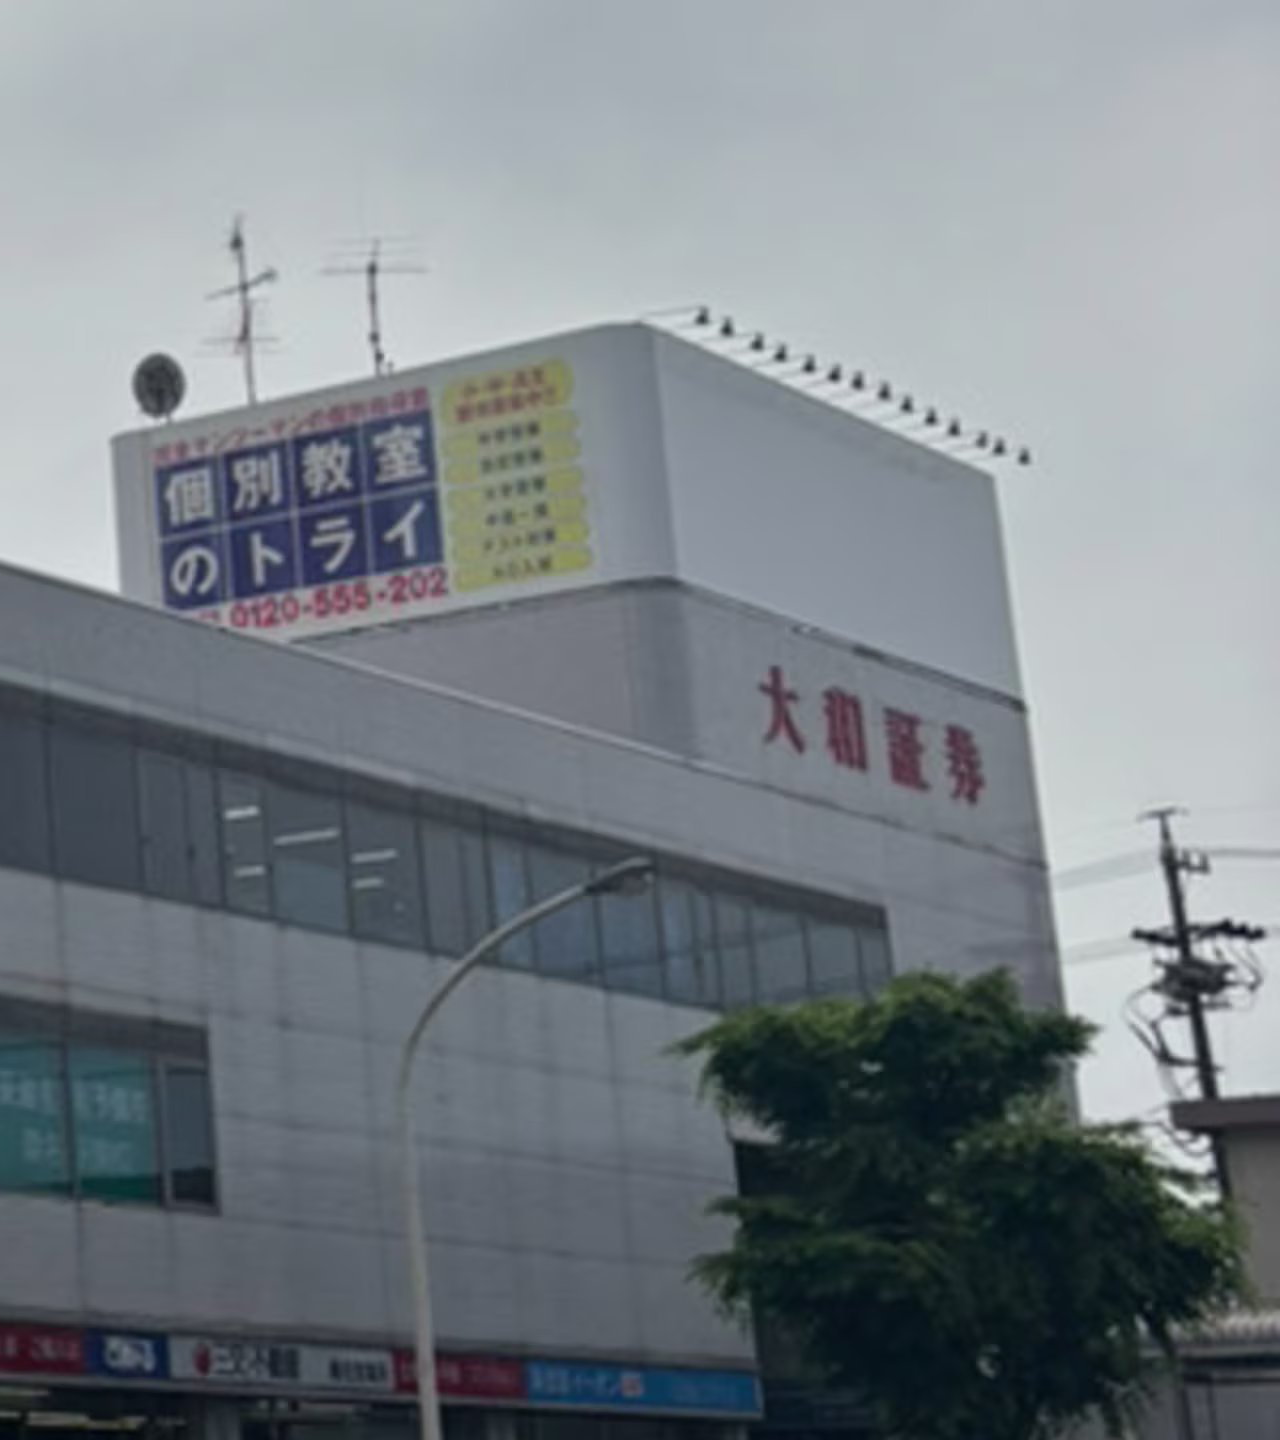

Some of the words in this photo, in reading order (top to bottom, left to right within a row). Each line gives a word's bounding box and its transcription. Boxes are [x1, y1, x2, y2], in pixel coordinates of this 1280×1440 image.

[164, 424, 428, 527] 個別教室
[169, 500, 425, 596] のトライ
[229, 566, 448, 628] 0120-555-202
[758, 664, 985, 806] 大和証券
